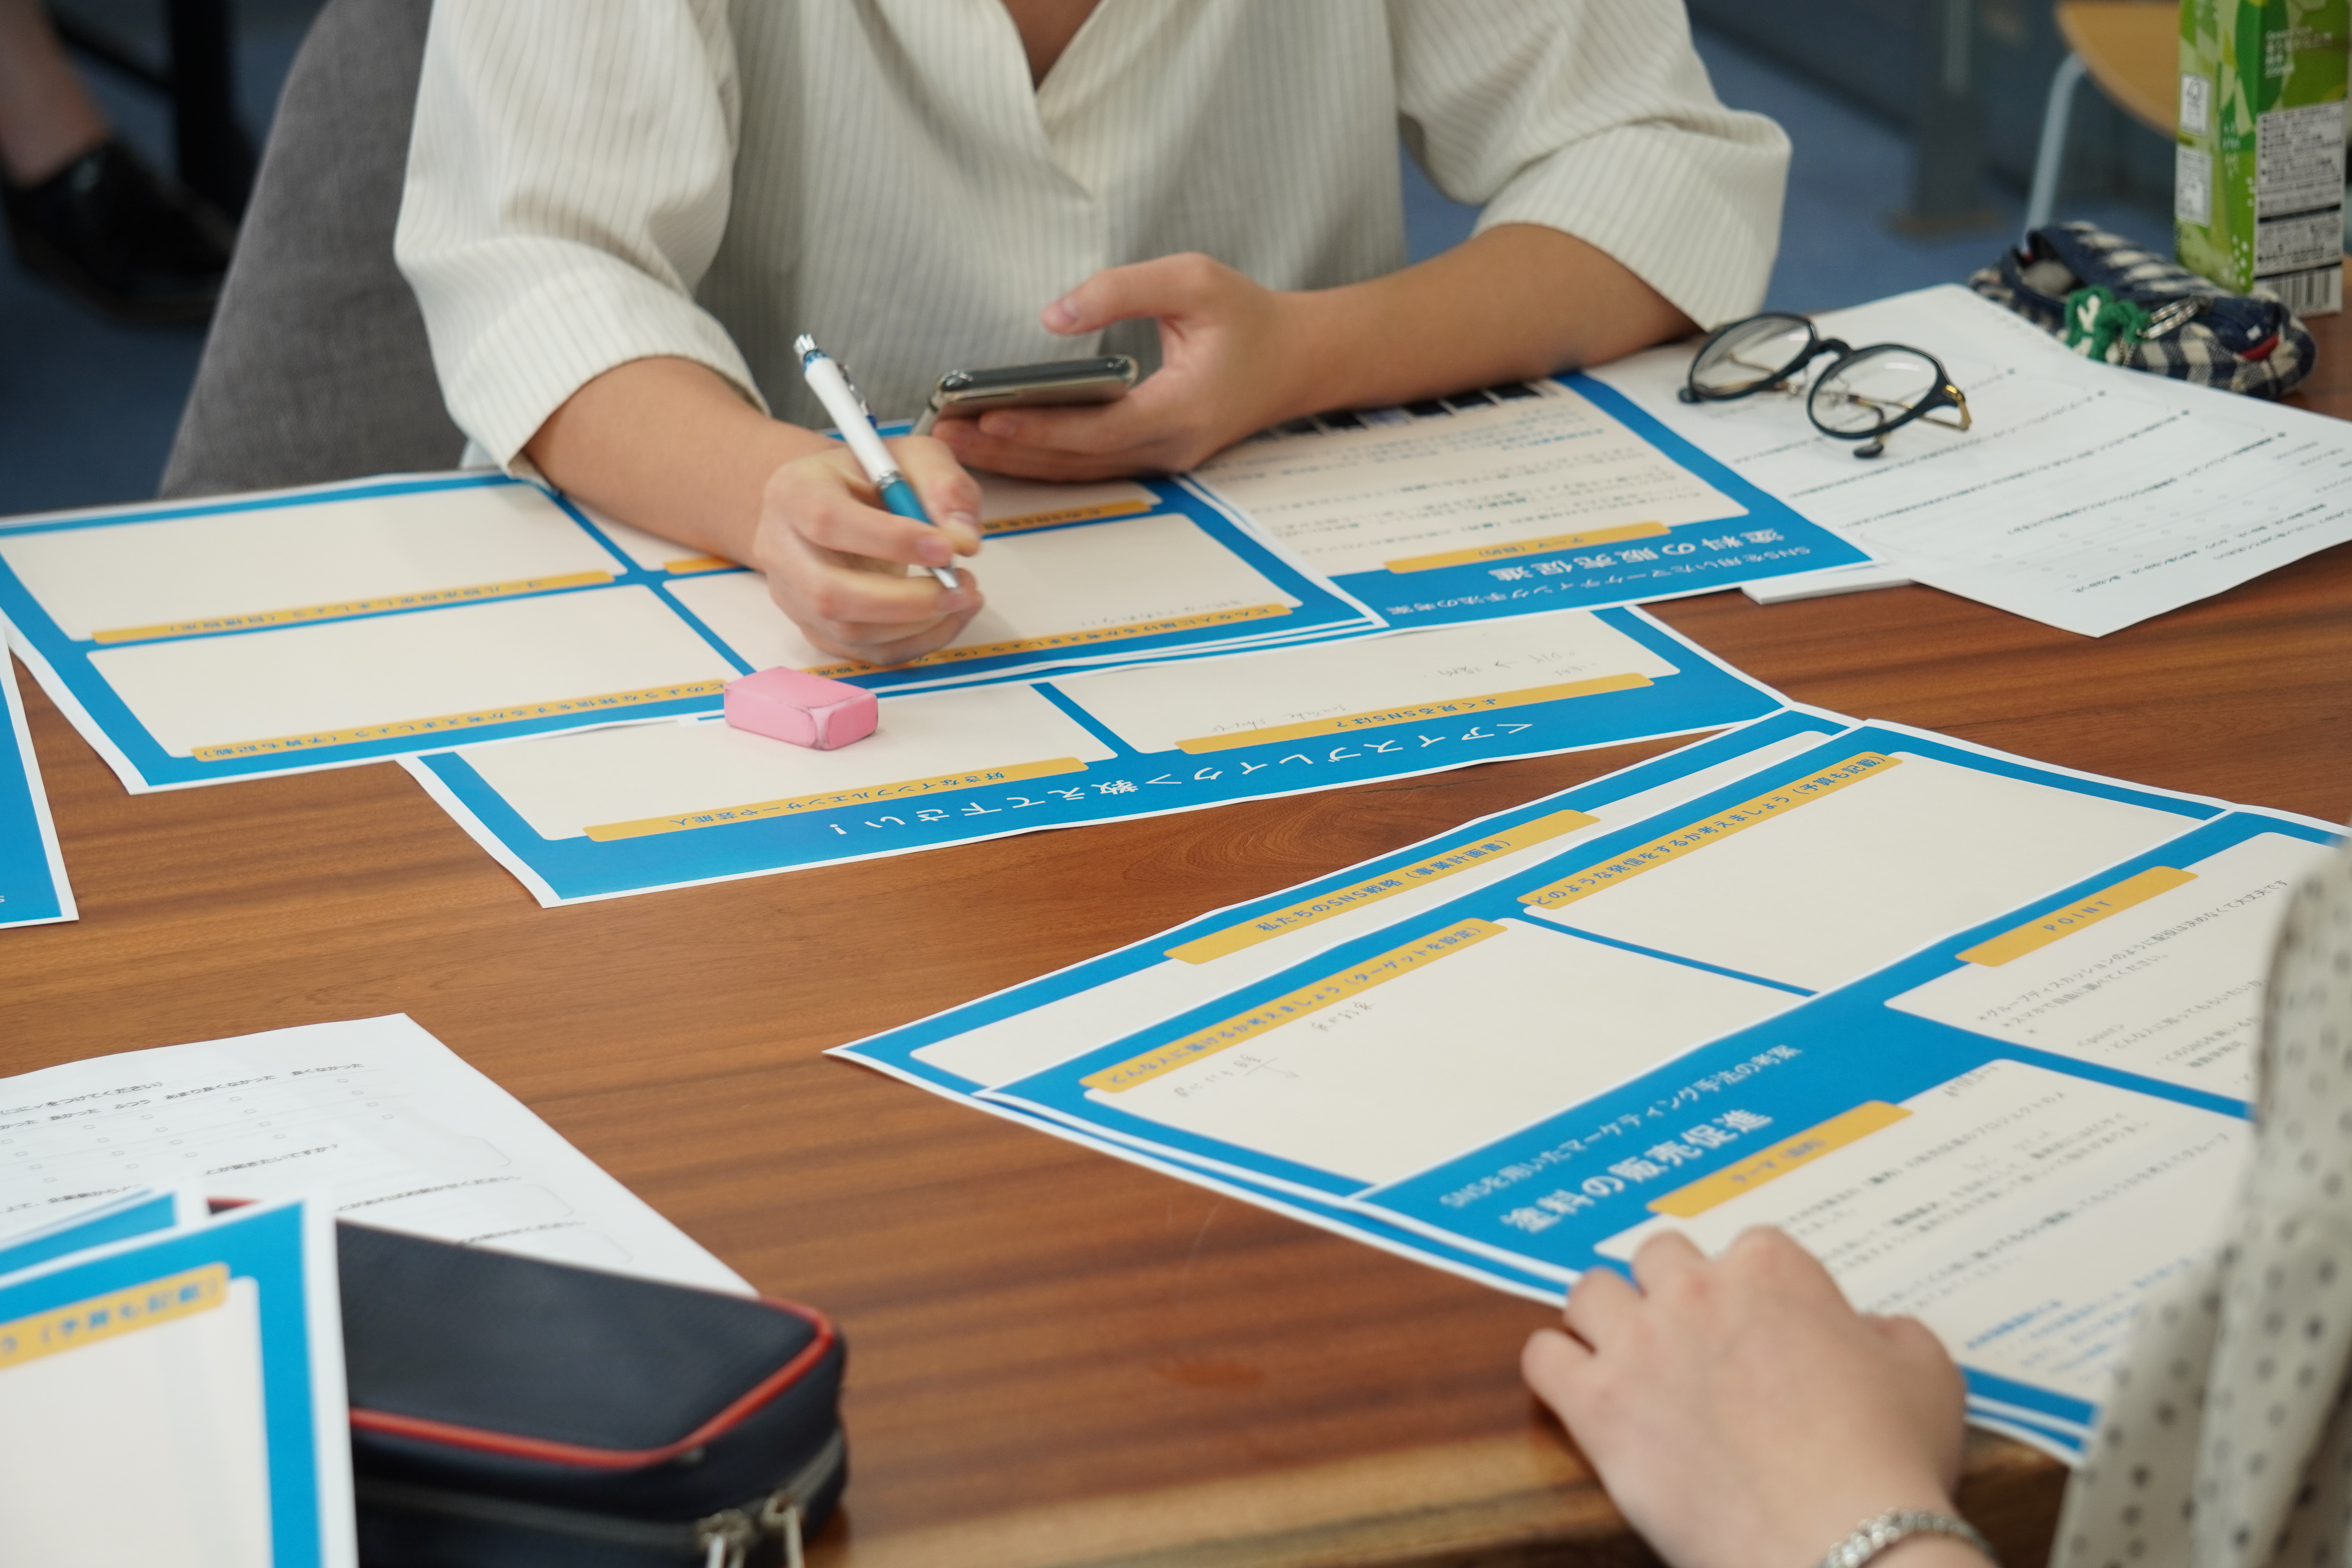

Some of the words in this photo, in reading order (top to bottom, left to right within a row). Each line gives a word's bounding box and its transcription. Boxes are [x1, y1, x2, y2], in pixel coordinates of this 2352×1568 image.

[1387, 546, 1811, 615] SNSを用いたマーケティング手法の考案
[1488, 528, 1786, 583] 塗料の販売促進
[1336, 697, 1497, 728] よく見るSNSは？
[670, 770, 1005, 826] 好きなインフルエンサーや芸能人
[1531, 753, 1888, 906] どのような発信をするか考えましょう（予算も記載）
[1255, 838, 1512, 933] 私たちのSNS戦略（事業計画書）
[2042, 898, 2114, 932] POINT
[1105, 924, 1483, 1087] どんな人に届けるか考えましょう（ターゲットを設定）
[114, 1099, 151, 1109] ふつう
[1439, 1042, 1803, 1209] SNSを用いたマーケティング手法の考案
[1501, 1108, 1775, 1235] 塗料の販売促進
